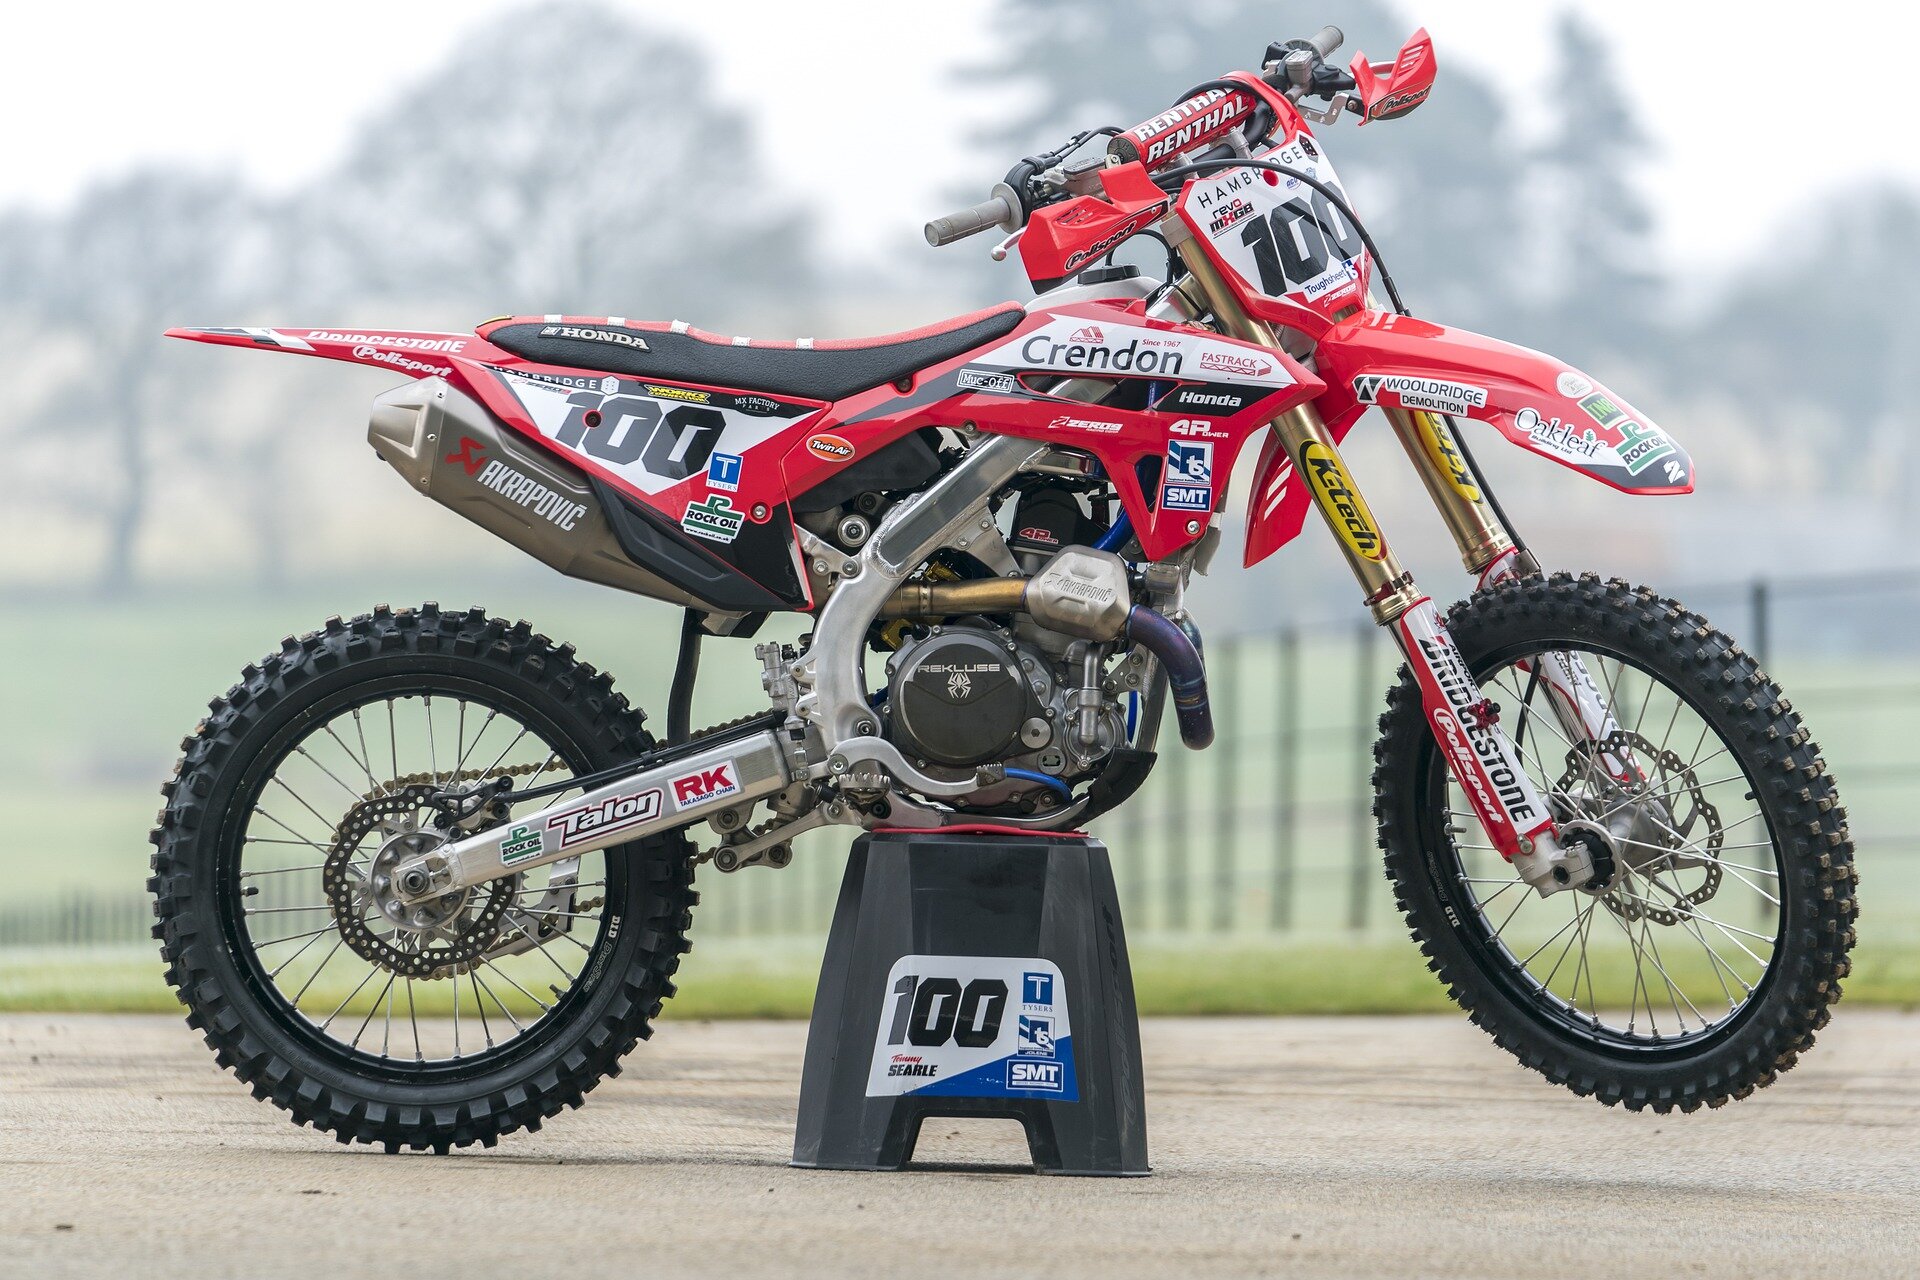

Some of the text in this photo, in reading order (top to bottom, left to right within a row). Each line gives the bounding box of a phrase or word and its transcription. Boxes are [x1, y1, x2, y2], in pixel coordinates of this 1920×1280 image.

[1147, 95, 1249, 163] RENTHAL
[1064, 220, 1137, 271] Polisport
[1241, 181, 1365, 297] 100
[1304, 269, 1346, 294] Toughsheet
[304, 331, 467, 353] BRIDGESTONE
[560, 327, 650, 350] HONDA
[1142, 338, 1181, 348] Since 1967
[353, 345, 453, 377] Polisport
[1021, 335, 1184, 375] Crendon
[1201, 352, 1258, 369] FASTRACK
[493, 366, 598, 389] HAMBRIDGE
[962, 373, 1010, 389] Muc-Off
[1178, 391, 1242, 407] Honda
[1386, 377, 1483, 405] WOOLDRIDGE
[748, 397, 780, 410] FACTORY
[1402, 395, 1464, 414] DEMOLITION
[555, 391, 727, 481] 100
[1516, 409, 1607, 459] Oakleaf
[812, 440, 851, 455] Twin Air
[1623, 436, 1667, 465] ROCK OIL
[477, 460, 588, 531] AKRAPOVIČ
[708, 480, 738, 491] TYSERS
[1167, 487, 1207, 504] SMT
[1307, 457, 1379, 550] K-tech
[687, 510, 739, 530] ROCK OIL
[917, 663, 1001, 673] REKLUSE
[1433, 708, 1504, 823] Polisport
[674, 765, 733, 802] RK
[680, 785, 736, 807] TAKASAGO CHAIN
[551, 790, 661, 836] Talon
[502, 838, 542, 856] ROCK OIL
[887, 975, 1009, 1048] 100
[1022, 1004, 1053, 1012] TYSERS
[891, 1053, 923, 1064] Tommy
[888, 1064, 938, 1077] SEARLE
[1012, 1063, 1058, 1081] SMT
